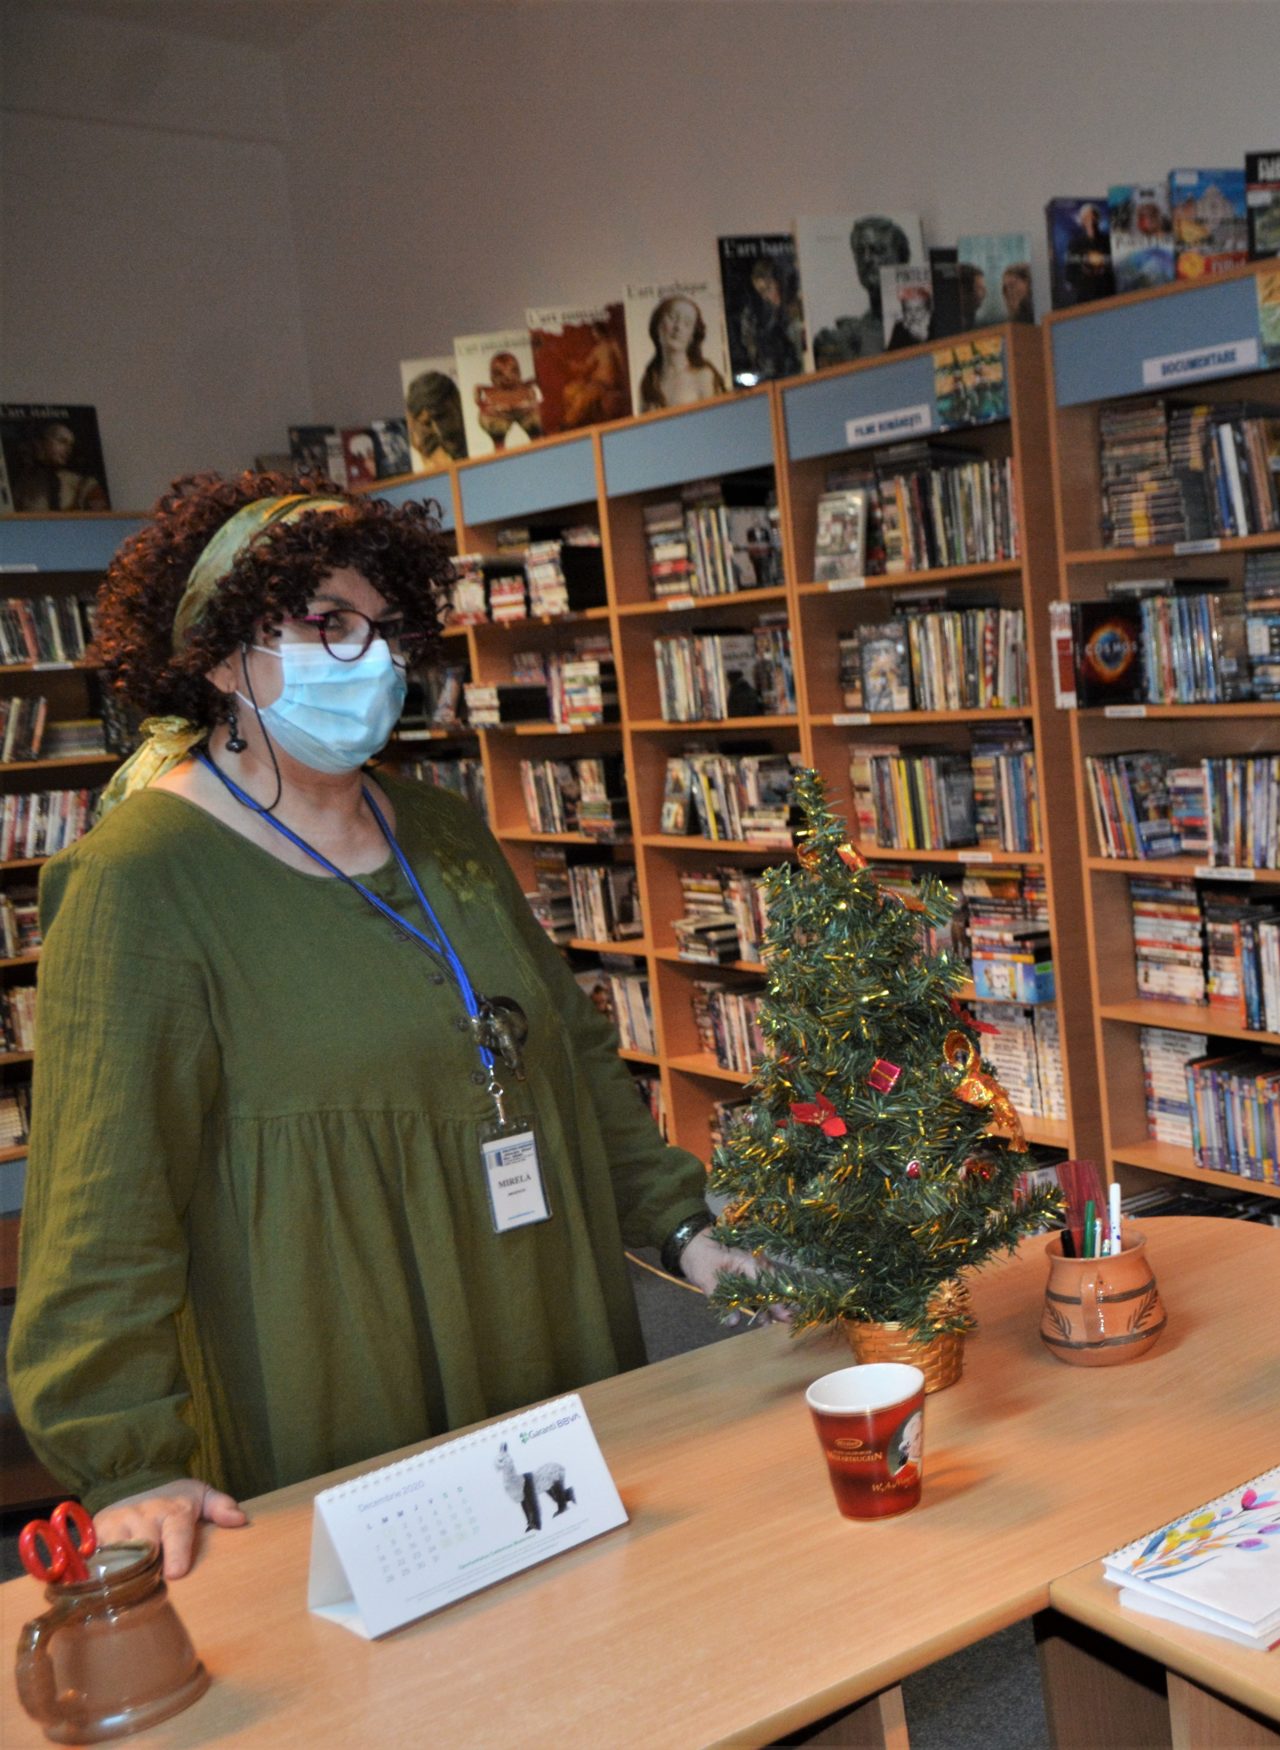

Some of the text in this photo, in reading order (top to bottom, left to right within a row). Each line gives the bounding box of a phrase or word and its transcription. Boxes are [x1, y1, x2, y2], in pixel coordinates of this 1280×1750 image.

[498, 1173, 532, 1188] MIRELA
[528, 1412, 582, 1440] Garanti BBVA
[358, 1480, 425, 1512] Decembrie 2020
